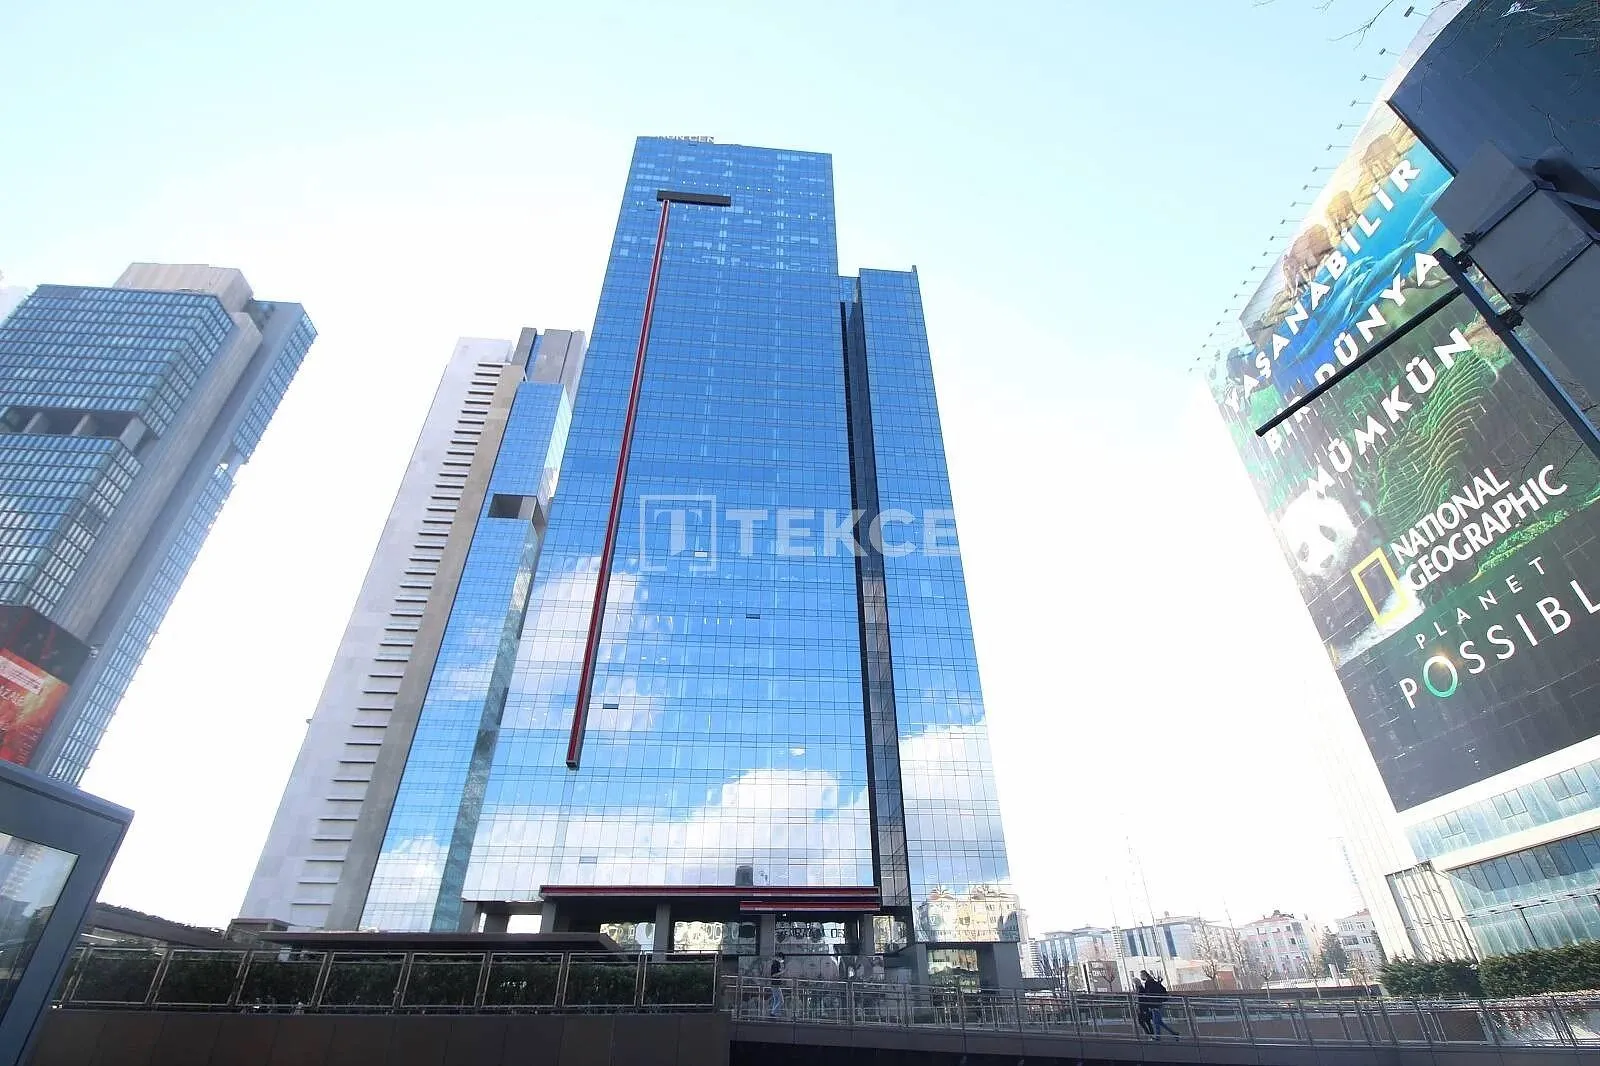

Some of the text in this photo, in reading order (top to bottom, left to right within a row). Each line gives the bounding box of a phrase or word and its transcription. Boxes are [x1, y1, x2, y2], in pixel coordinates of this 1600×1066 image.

[1225, 159, 1420, 413] YAŞANABİLİR
[1307, 327, 1472, 500] MÜMKÜN
[1390, 468, 1510, 564] NATIONAL
[1405, 465, 1568, 591] GEOGRAPHIC
[1415, 557, 1545, 649] PLANET
